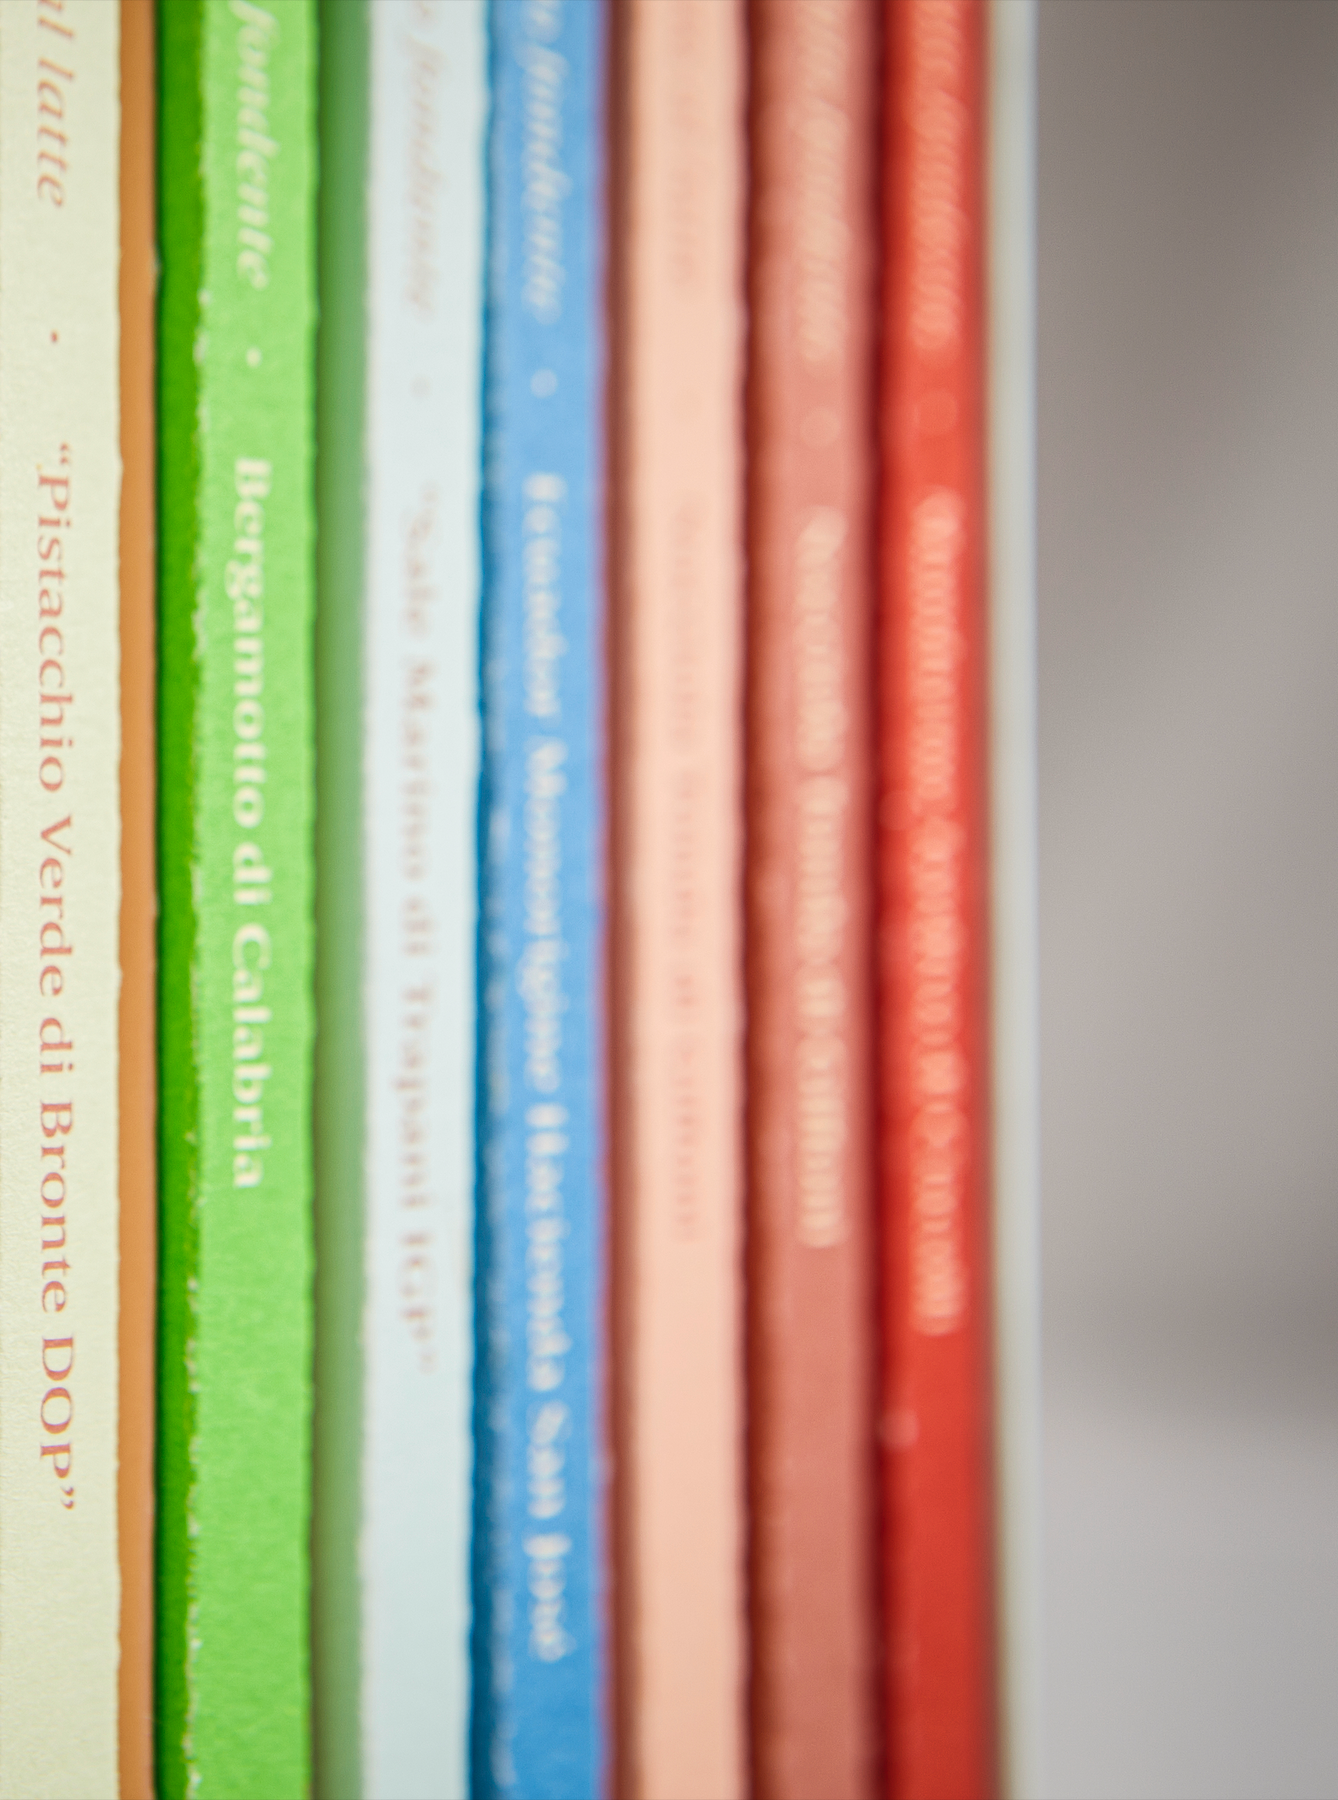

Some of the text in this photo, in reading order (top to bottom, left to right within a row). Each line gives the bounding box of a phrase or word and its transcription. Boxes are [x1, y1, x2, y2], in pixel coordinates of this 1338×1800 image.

[37, 57, 76, 208] latte
[224, 0, 283, 1189] fondente Bergamotto di Calabria
[38, 814, 74, 997] Verde
[38, 1014, 75, 1075] di
[39, 1101, 75, 1314] Bronte
